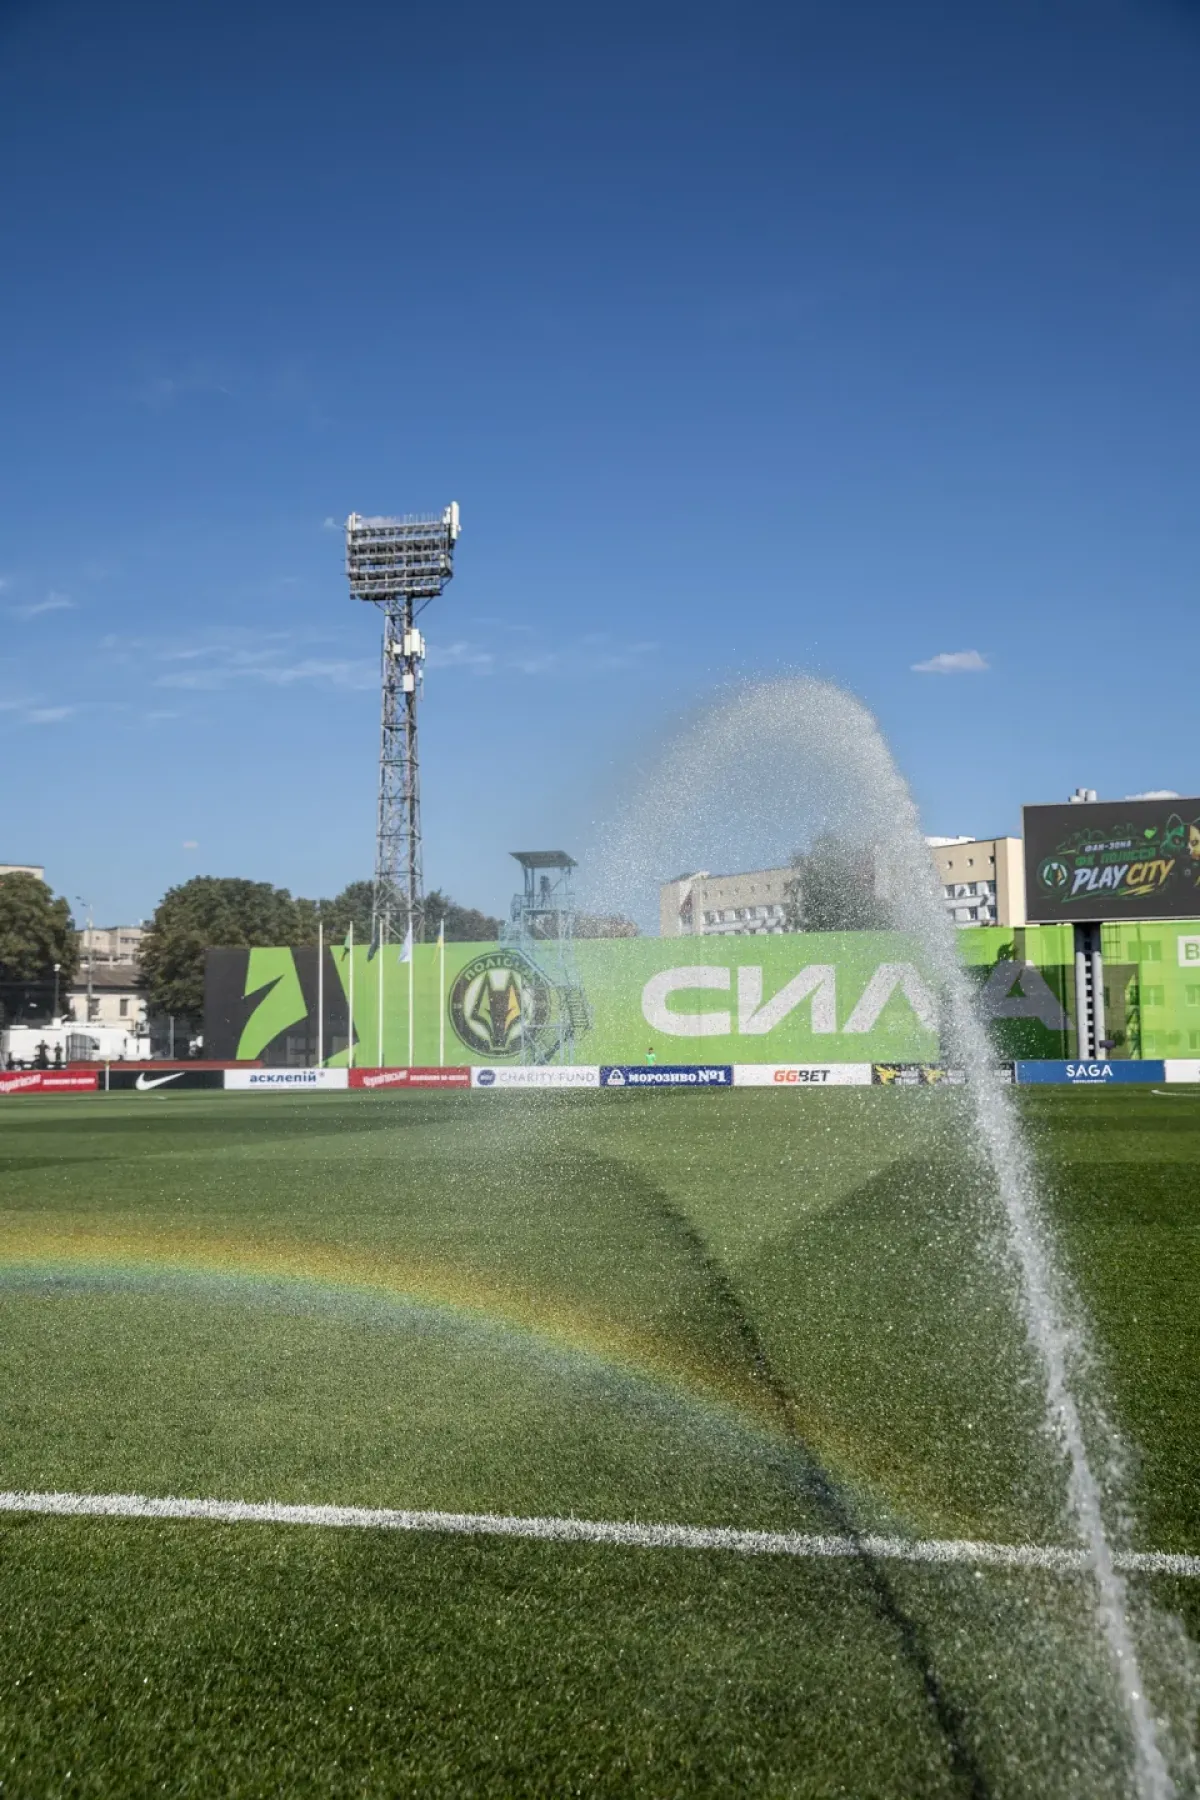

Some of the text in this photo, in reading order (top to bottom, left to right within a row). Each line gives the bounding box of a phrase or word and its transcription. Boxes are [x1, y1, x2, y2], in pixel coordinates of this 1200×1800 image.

[464, 956, 535, 982] ПОЛІС
[641, 961, 1076, 1037] СИЛА
[249, 1070, 317, 1083] асклепій
[500, 1072, 553, 1082] CHARITY
[559, 1072, 595, 1082] FUND
[1066, 1064, 1114, 1077] SAGA
